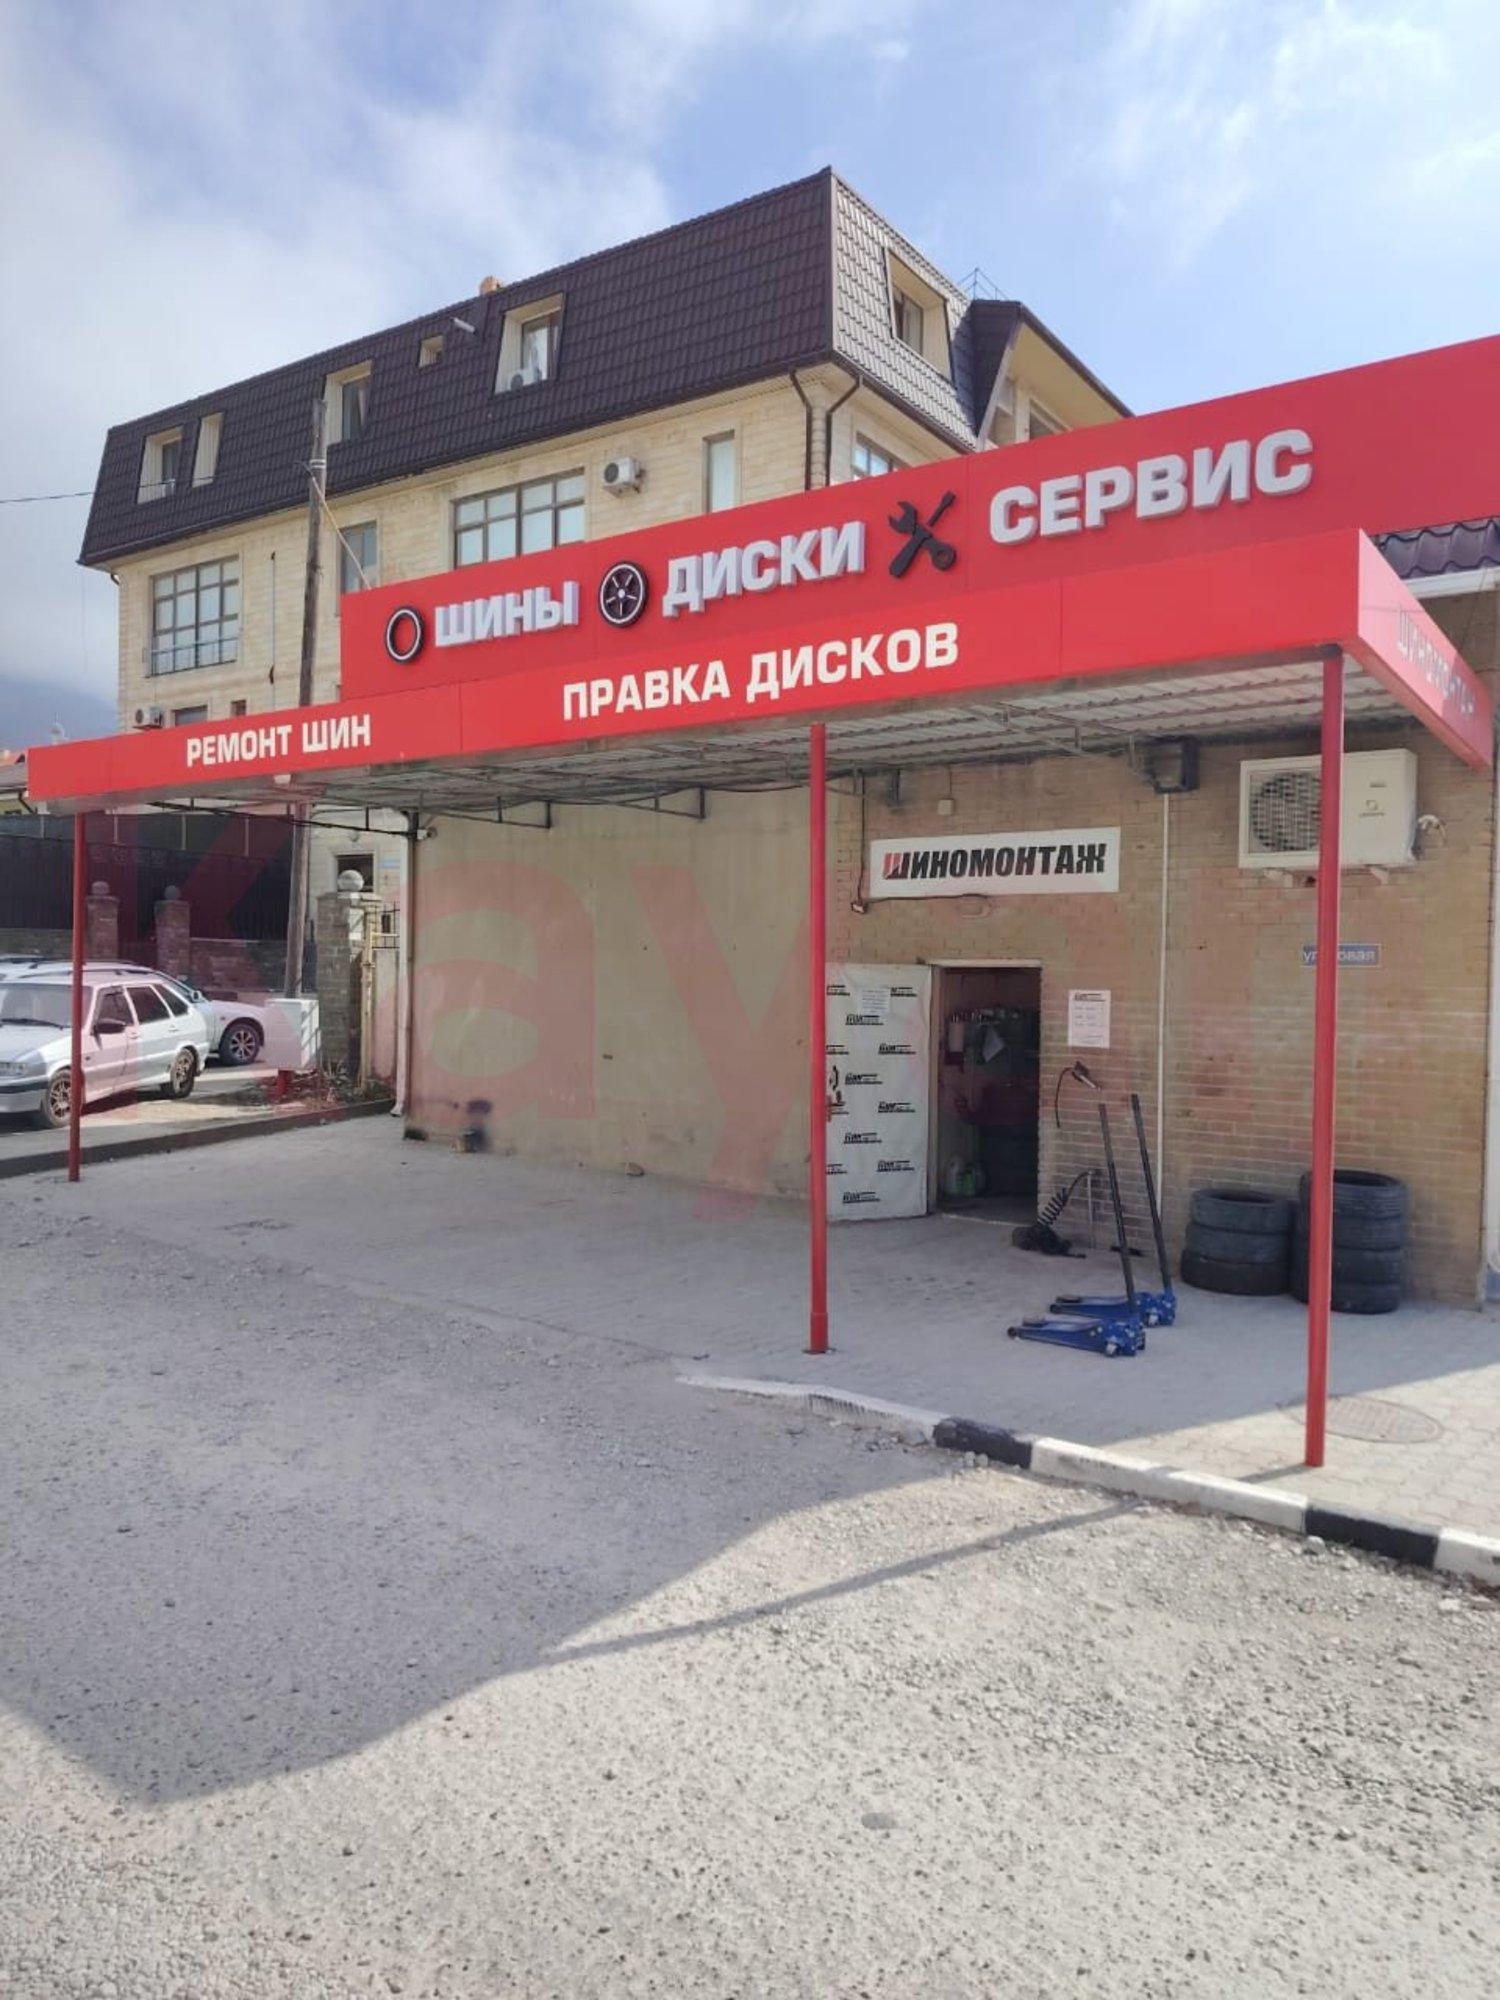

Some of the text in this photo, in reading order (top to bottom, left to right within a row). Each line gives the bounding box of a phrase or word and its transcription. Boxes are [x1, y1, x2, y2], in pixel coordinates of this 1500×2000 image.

[434, 428, 1314, 648] ШИНЫ ДИСКИ СЕРВИС
[563, 621, 958, 721] ПРАВКА ДИСКОВ
[186, 714, 371, 768] РЕМОНТ ШИН
[882, 842, 1108, 881] ШИНОМОНТАЖ
